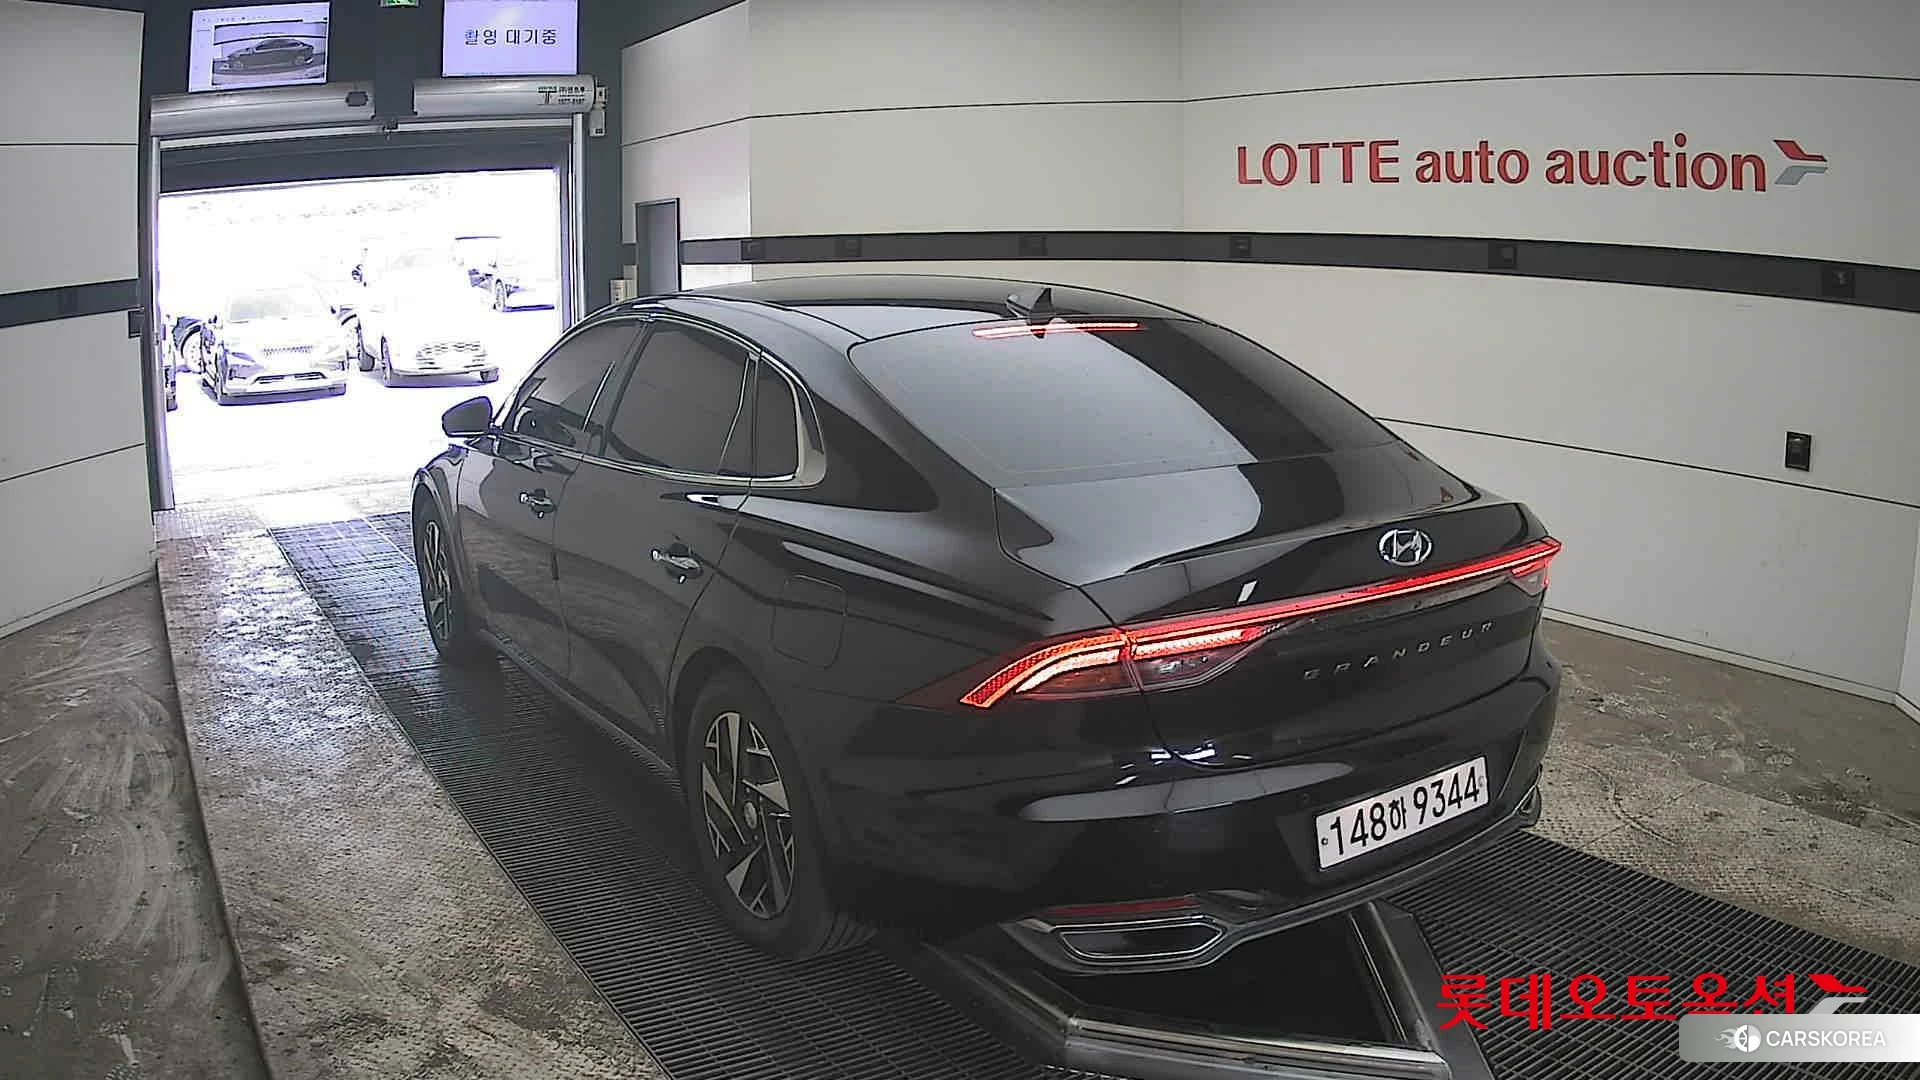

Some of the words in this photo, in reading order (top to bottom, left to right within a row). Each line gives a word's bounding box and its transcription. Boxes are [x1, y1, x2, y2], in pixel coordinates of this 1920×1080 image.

[465, 29, 497, 45] 촬영
[506, 29, 557, 45] 대기중
[1237, 139, 1400, 186] LOTTE
[1415, 140, 1530, 184] auto
[1545, 132, 1767, 193] auction
[1304, 621, 1493, 681] GRANDEUR
[1330, 796, 1407, 856] 148하
[1413, 766, 1480, 826] 9344
